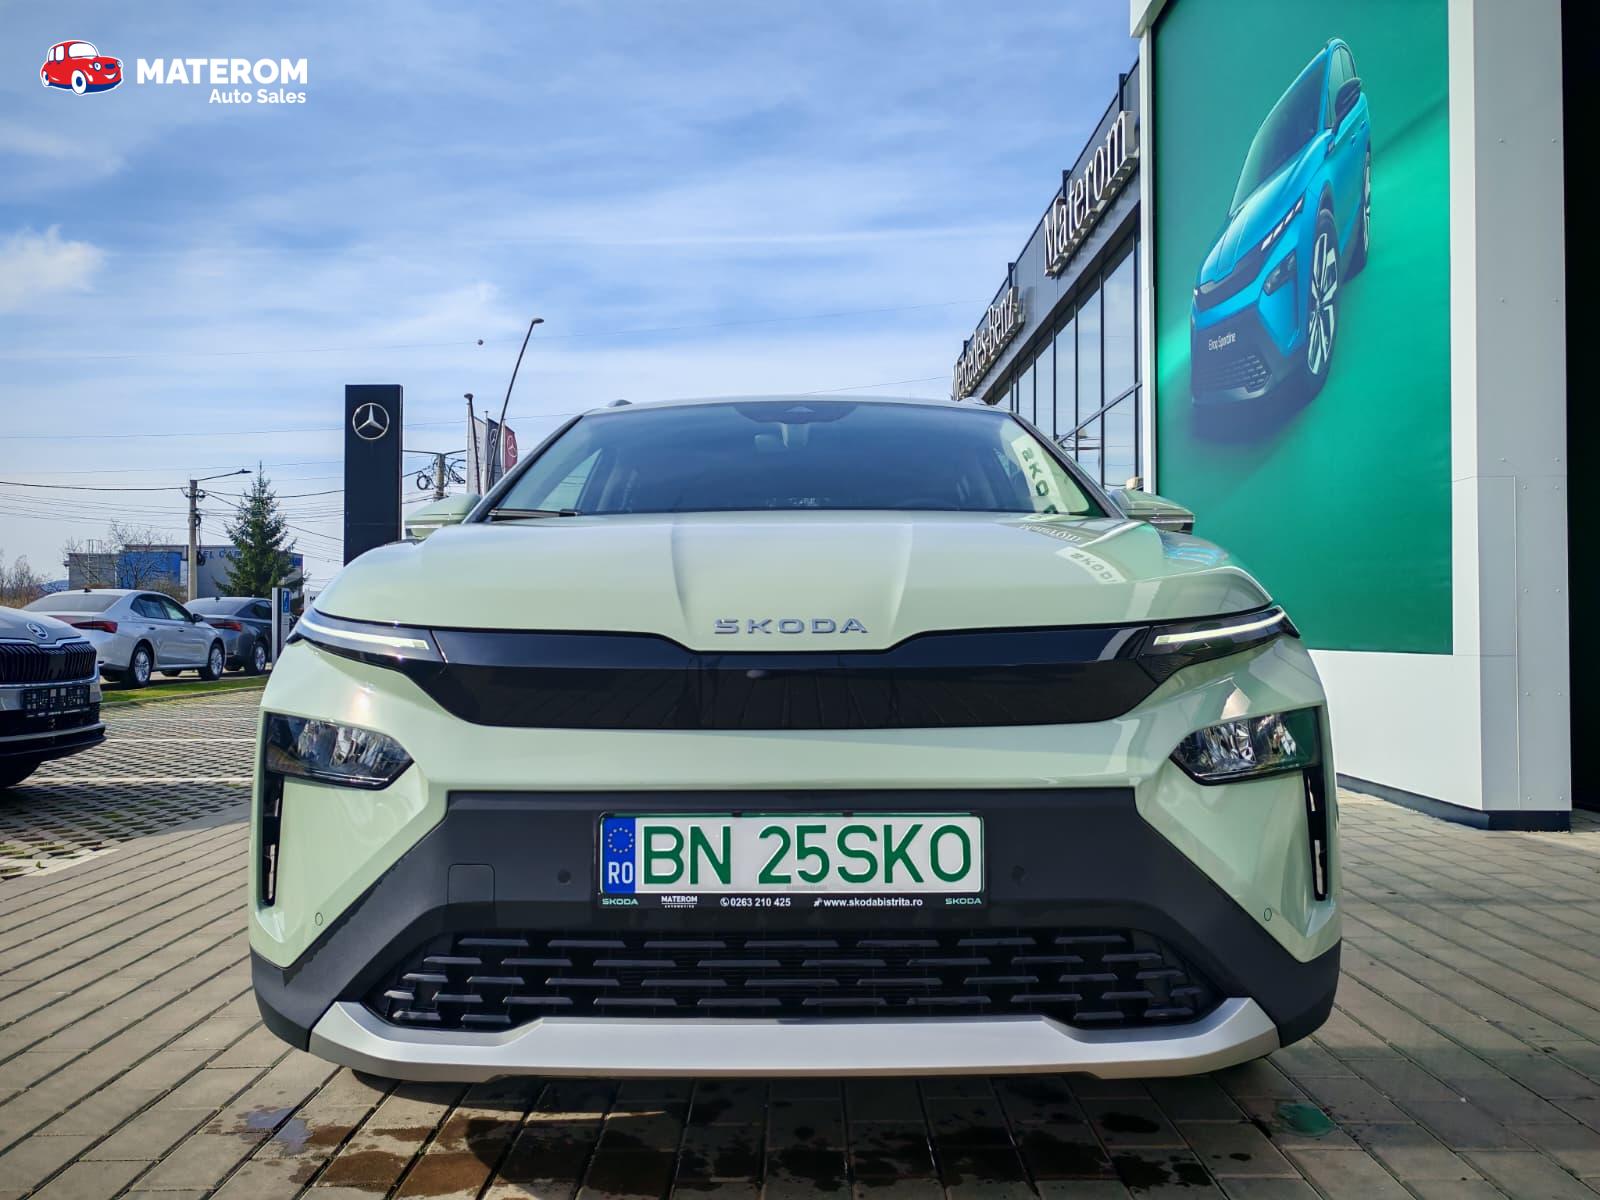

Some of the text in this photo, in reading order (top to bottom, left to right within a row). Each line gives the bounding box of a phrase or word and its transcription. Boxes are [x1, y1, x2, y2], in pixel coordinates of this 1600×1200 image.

[1044, 110, 1135, 277] Materom
[714, 618, 868, 635] SKODA
[608, 823, 971, 885] RO BN 25SKO
[602, 898, 638, 906] SKODA
[661, 895, 698, 903] MATEROM
[730, 897, 791, 907] 0263 210 425
[823, 897, 923, 908] www.skodabistrita.ro
